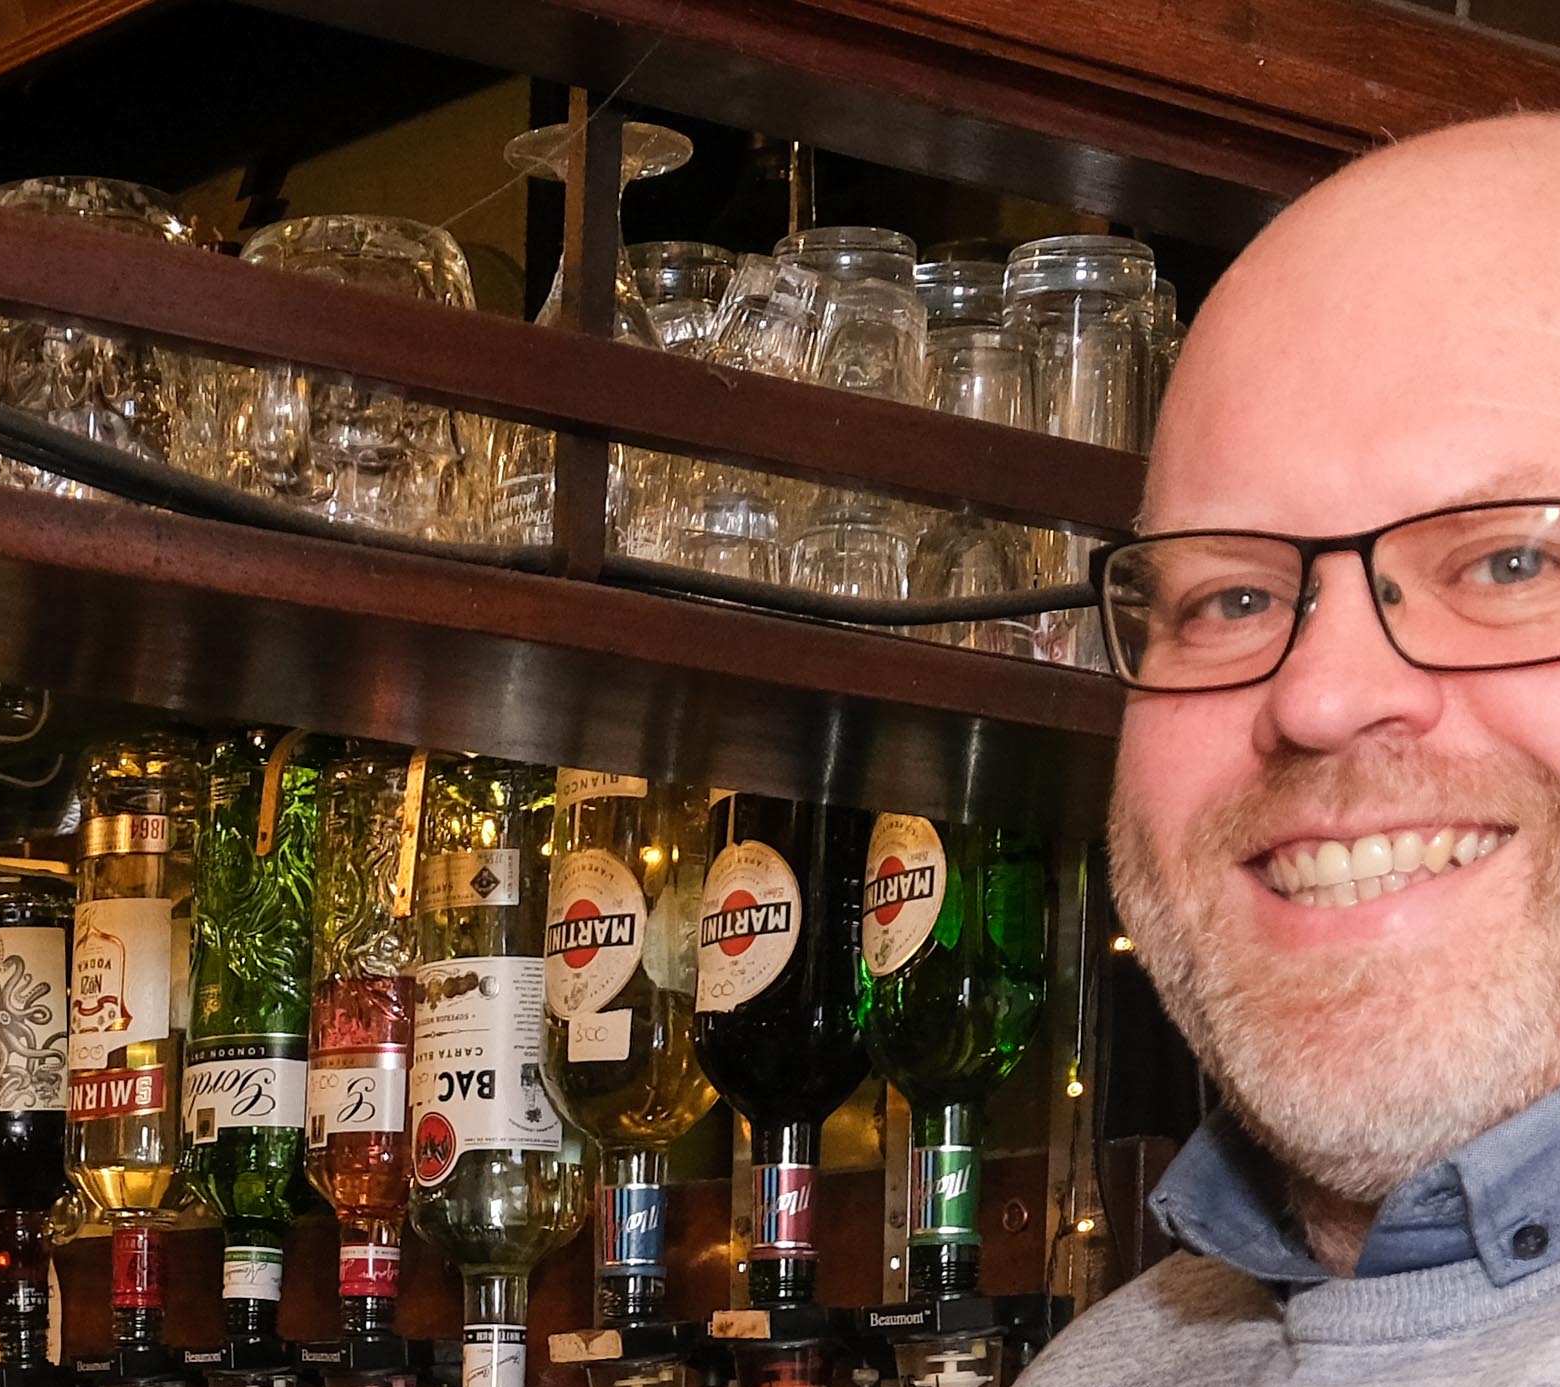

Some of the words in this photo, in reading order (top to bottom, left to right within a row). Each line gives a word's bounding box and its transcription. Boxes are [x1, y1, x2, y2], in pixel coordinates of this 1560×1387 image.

[130, 817, 166, 841] 1864
[702, 904, 788, 943] MARTINI
[547, 915, 630, 955] MARTINI
[209, 1045, 265, 1059] LONDON
[437, 1046, 484, 1059] CARTA
[437, 1069, 497, 1104] BAC
[869, 1311, 925, 1327] Beaumont
[184, 1349, 223, 1364] Beaumont
[301, 1348, 343, 1364] Beaumont
[76, 1358, 112, 1374] Beaumont
